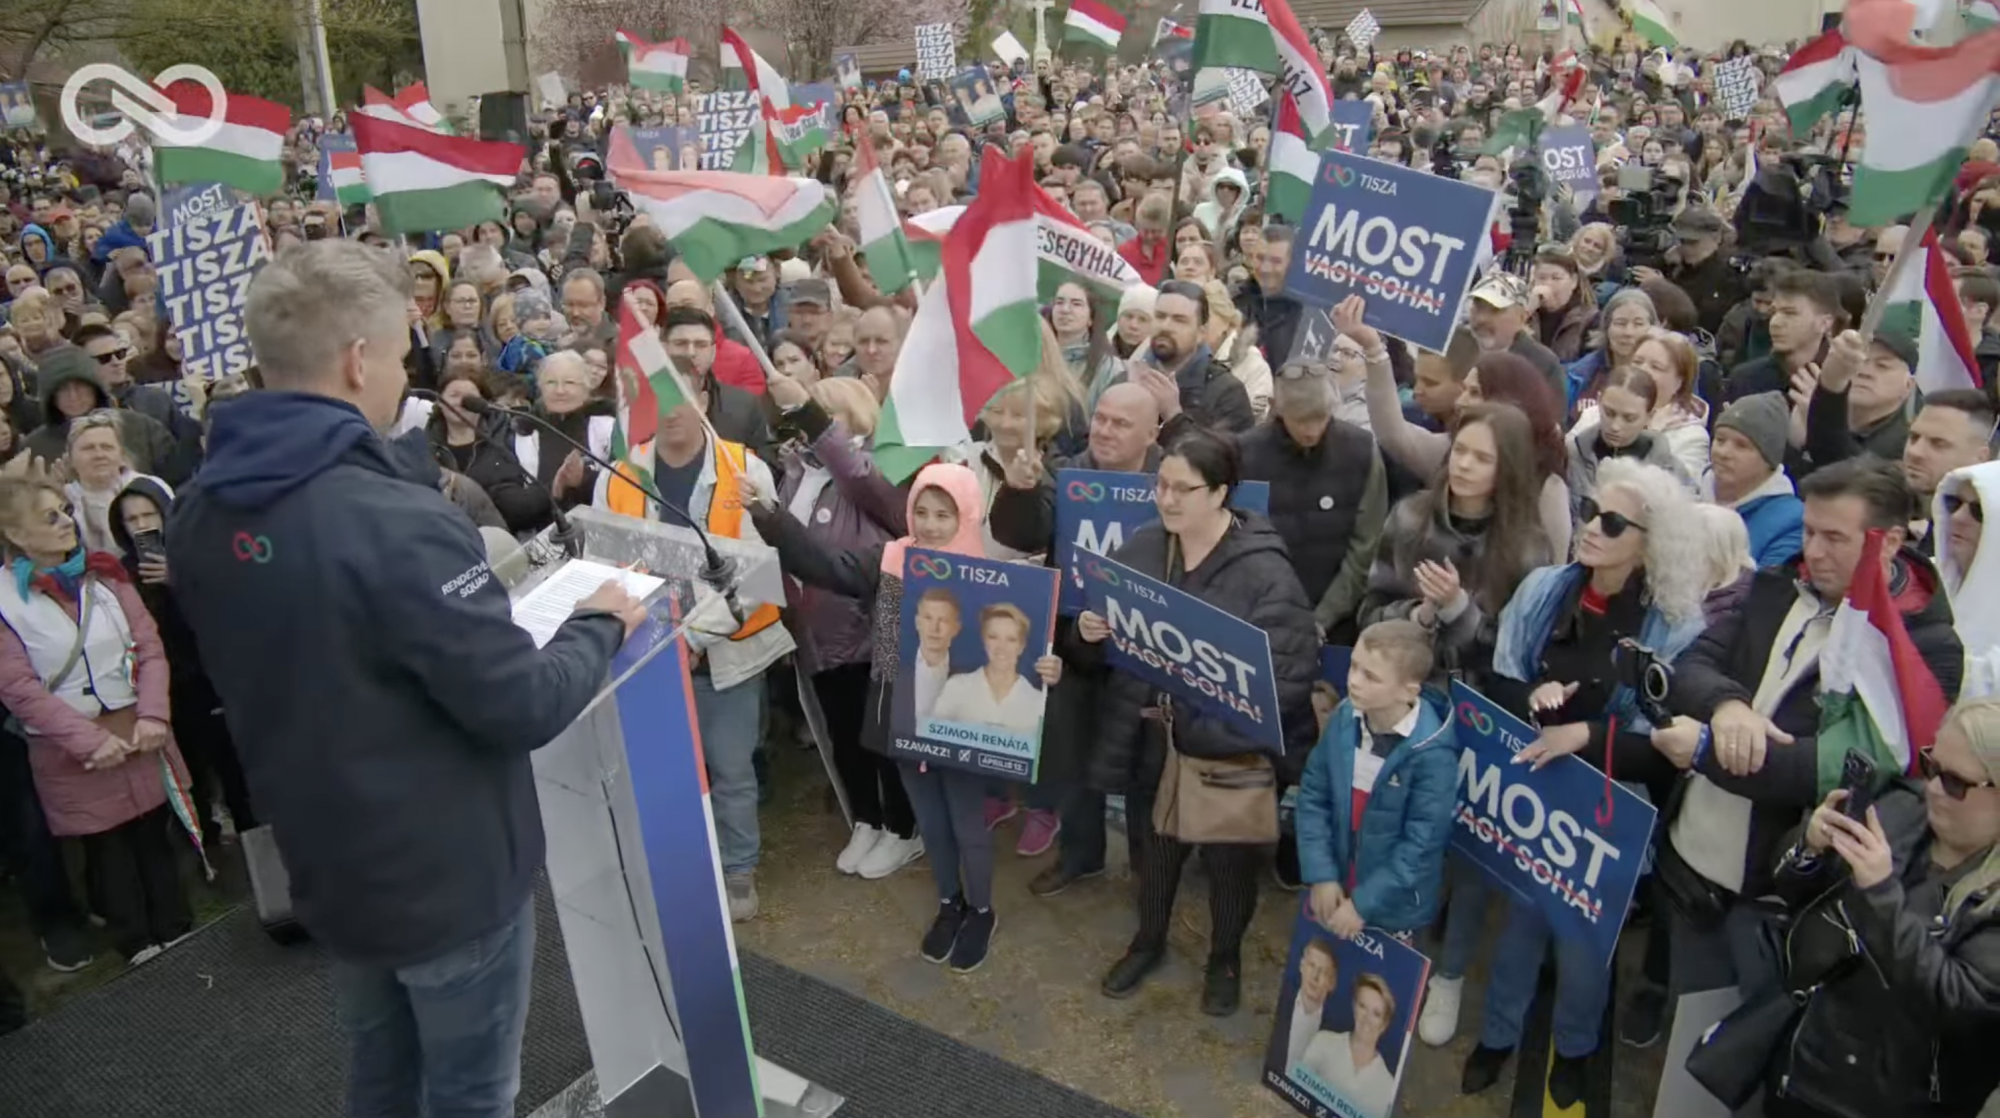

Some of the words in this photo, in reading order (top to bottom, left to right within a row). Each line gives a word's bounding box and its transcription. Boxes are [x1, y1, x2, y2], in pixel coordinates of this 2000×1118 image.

[696, 90, 760, 112] TISZA
[699, 130, 750, 151] TISZ
[1544, 145, 1585, 170] OST
[701, 149, 736, 169] TIS
[1360, 174, 1398, 196] TISZA
[172, 183, 222, 226] MOST
[145, 201, 261, 263] TISZA
[1308, 203, 1466, 284] MOST
[156, 234, 273, 296] TISZA
[1305, 250, 1366, 288] VAGY
[1365, 271, 1446, 316] SOHA!
[165, 272, 251, 328] TISZ
[176, 311, 241, 359] TIS
[186, 344, 249, 380] TIS
[1110, 486, 1156, 502] TISZA
[460, 572, 489, 598] SQUAD
[957, 564, 1010, 587] TISZA
[1124, 579, 1168, 608] TISZA
[1105, 595, 1256, 698] MOST
[1109, 629, 1179, 676] VAGY
[1182, 667, 1263, 724] SOHA!
[895, 738, 951, 758] SZAVAZZ!
[928, 723, 978, 742] SZIMON
[981, 733, 1030, 753] RENÁTA
[1498, 727, 1529, 754] TIS
[1456, 747, 1620, 889] MOST
[1514, 845, 1603, 925] SOHA!
[1350, 931, 1384, 960] ISZA
[1267, 1070, 1311, 1110] SZAVAZZ!
[1295, 1068, 1335, 1104] SZIMON
[1336, 1098, 1364, 1118] REN
